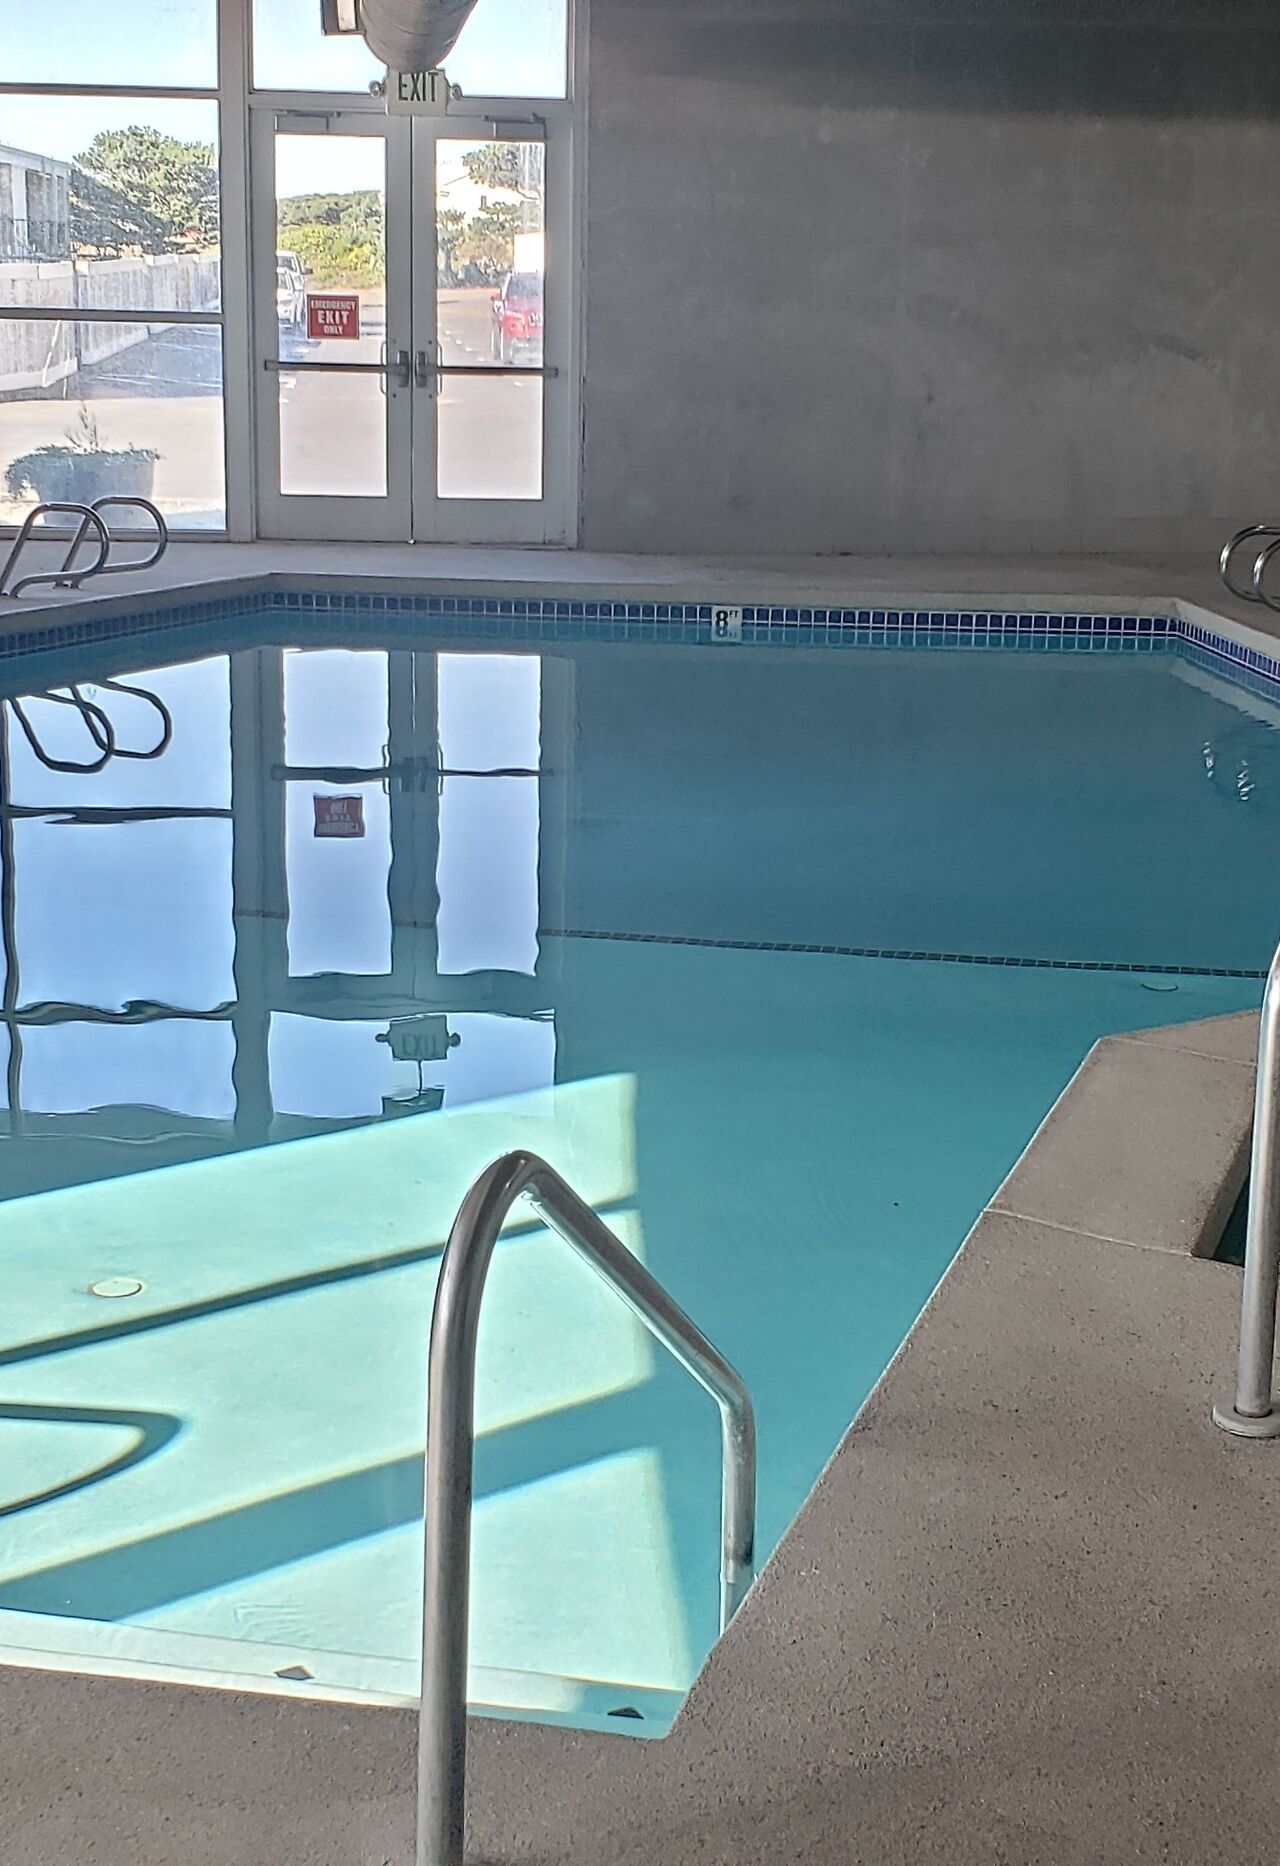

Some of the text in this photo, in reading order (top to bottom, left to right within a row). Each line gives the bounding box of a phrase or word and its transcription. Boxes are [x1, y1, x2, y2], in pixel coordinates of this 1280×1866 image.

[398, 71, 439, 102] EXIT
[317, 310, 350, 325] EXIT
[323, 325, 343, 335] ONLY
